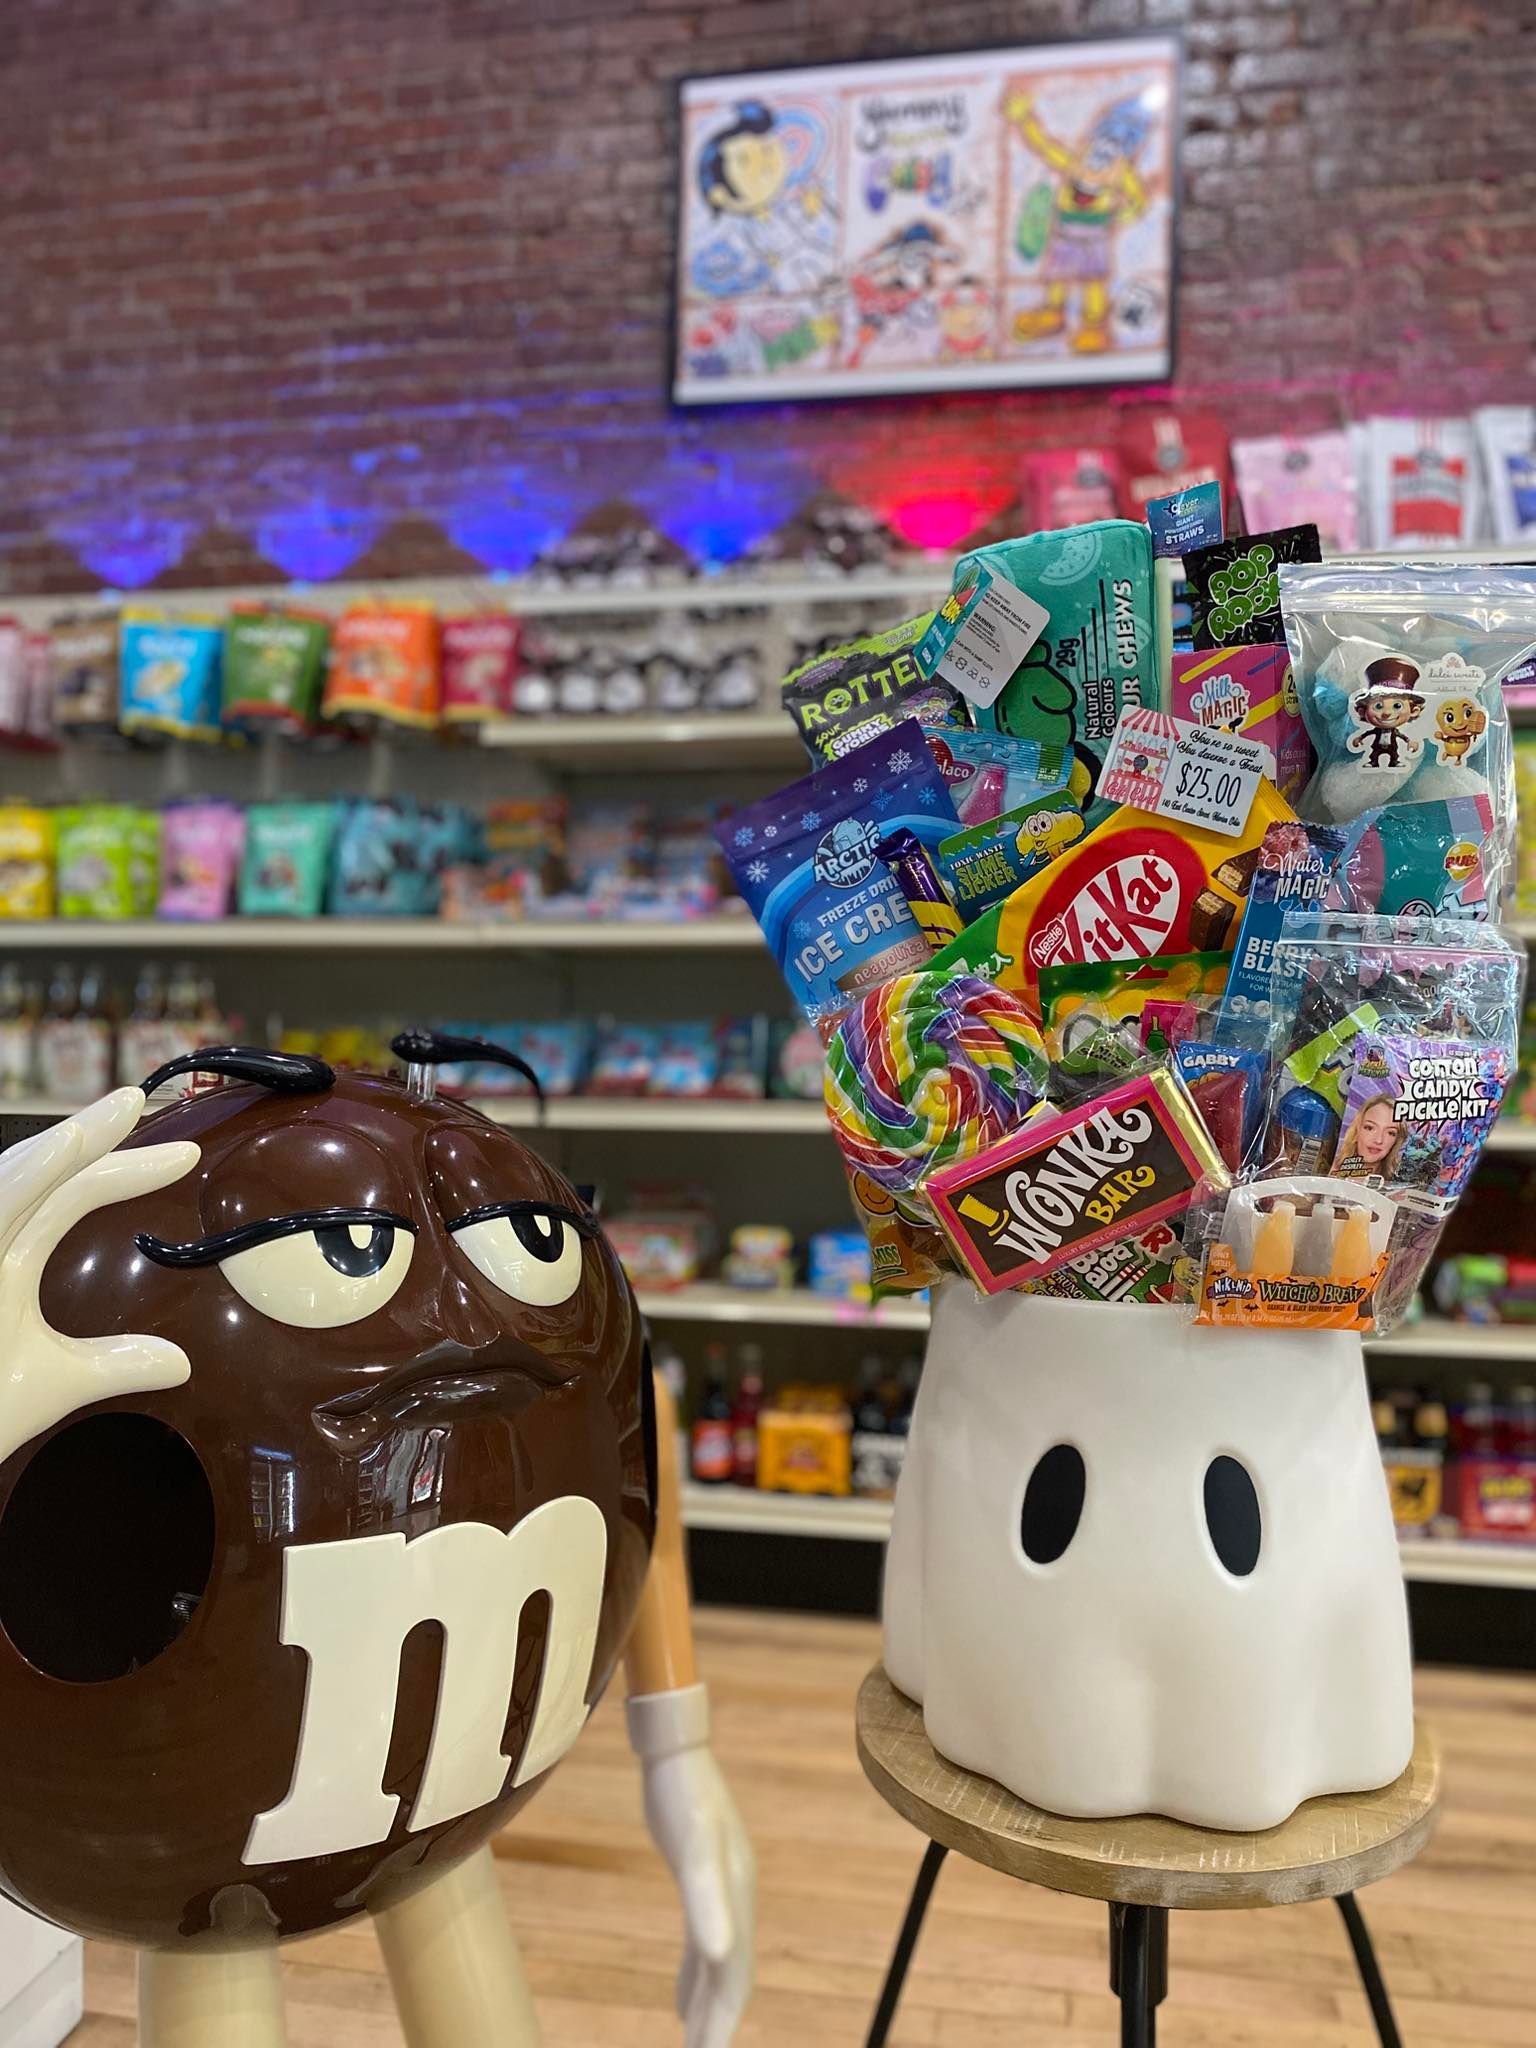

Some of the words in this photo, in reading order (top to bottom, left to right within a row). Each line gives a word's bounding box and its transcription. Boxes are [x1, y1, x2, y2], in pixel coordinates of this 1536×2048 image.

[1165, 525, 1205, 545] STRAWS
[1113, 578, 1139, 670] CHEWS
[1101, 678, 1114, 738] Colours
[1191, 676, 1242, 711] Milk
[1083, 682, 1100, 740] Natural
[1202, 695, 1247, 727] MAGIC
[831, 717, 883, 750] GUMMY
[834, 721, 890, 758] WORMS
[1234, 746, 1260, 758] sweet
[1176, 761, 1242, 808] $25.00
[814, 832, 883, 883] ARCTIC
[949, 854, 974, 870] TOXIC
[975, 843, 1005, 859] WASTE
[956, 851, 1008, 884] SLIME
[1263, 851, 1332, 878] Water
[1274, 875, 1331, 904] MAGIC
[817, 891, 870, 928] FREEZE
[1058, 857, 1173, 964] KitKat
[794, 930, 845, 984] ICE
[844, 891, 913, 945] CRE
[1033, 925, 1063, 960] Nestlé
[1247, 936, 1312, 963] BERRY
[1243, 953, 1308, 979] BLAST
[1250, 983, 1264, 991] FOR
[1183, 1054, 1241, 1068] GABBY
[1461, 1099, 1489, 1118] KIT
[994, 1106, 1153, 1265] WONKA
[1085, 1165, 1156, 1225] BAR
[1104, 1221, 1138, 1240] CHOCOLATE
[1258, 1280, 1319, 1302] WITCH'S
[1322, 1284, 1365, 1303] BREW
[241, 1495, 607, 1866] m
